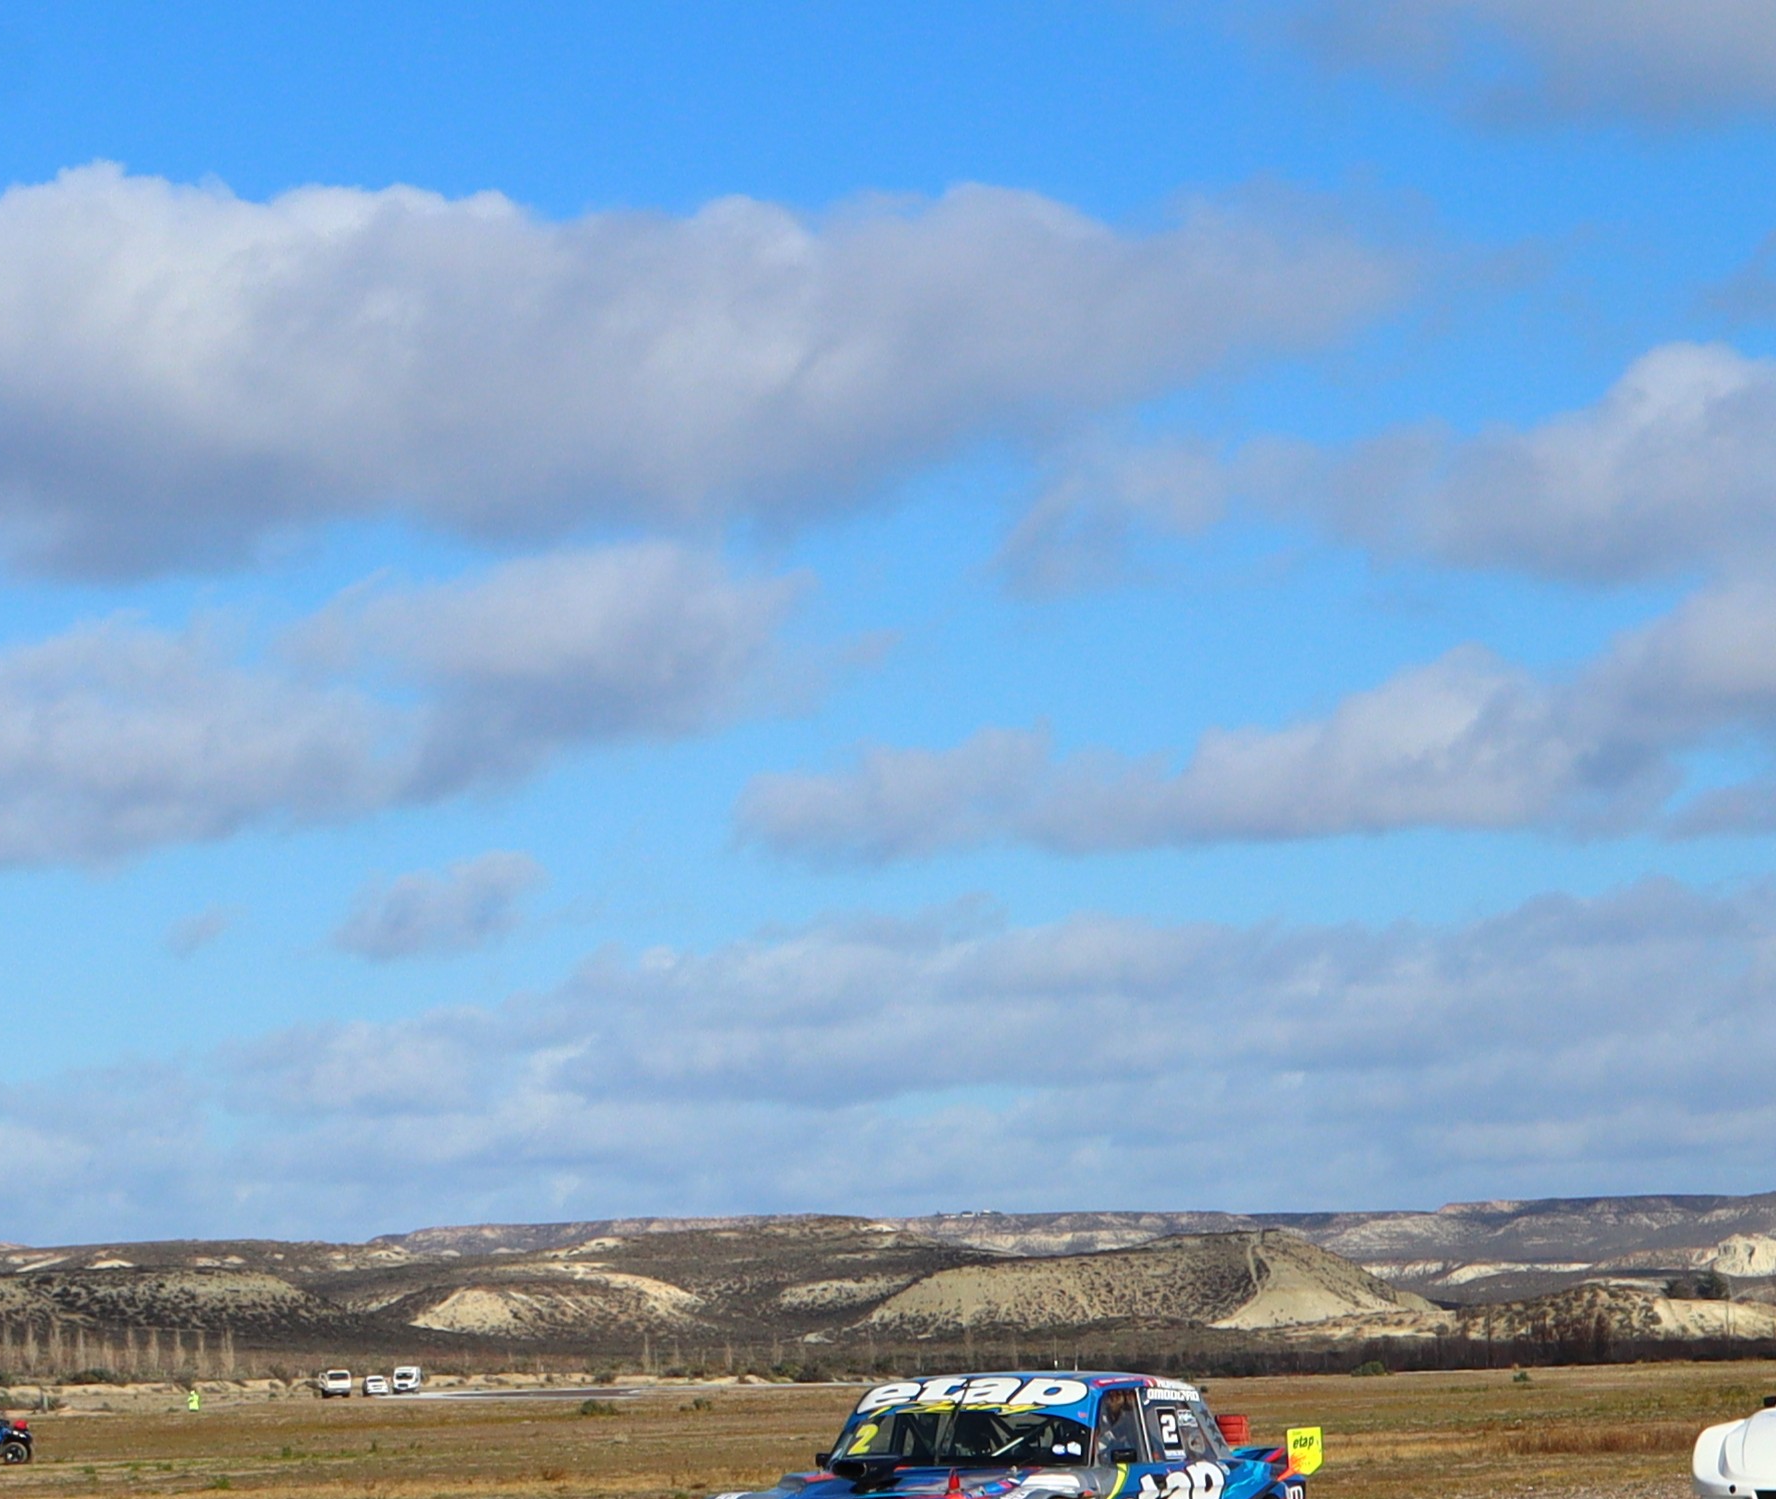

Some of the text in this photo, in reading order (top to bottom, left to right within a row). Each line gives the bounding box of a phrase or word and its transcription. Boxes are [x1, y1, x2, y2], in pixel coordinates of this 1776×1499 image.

[857, 1377, 1088, 1414] etap
[847, 1424, 879, 1455] 2
[1161, 1413, 1178, 1444] 2
[1293, 1435, 1315, 1450] etap
